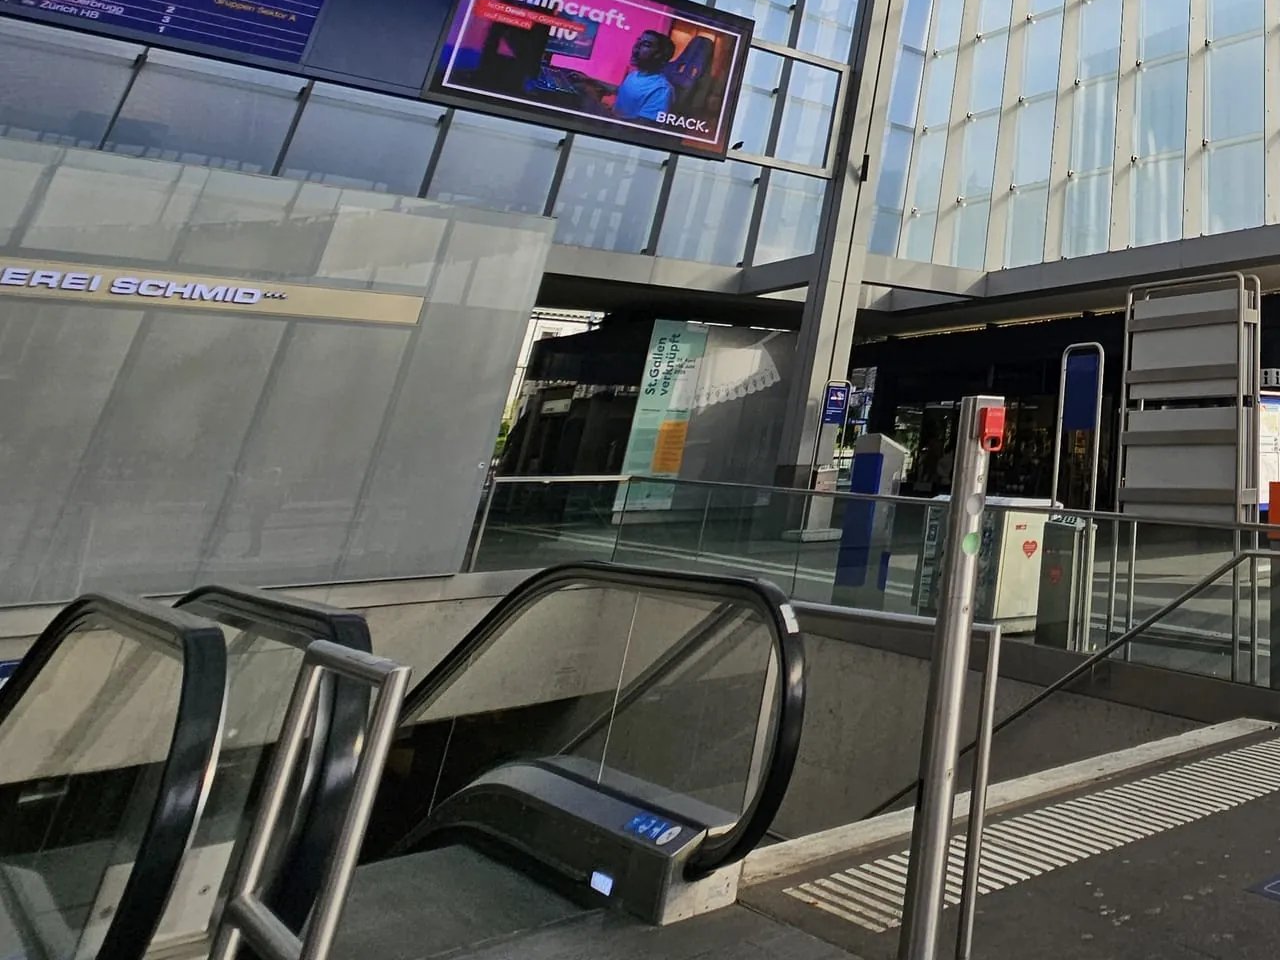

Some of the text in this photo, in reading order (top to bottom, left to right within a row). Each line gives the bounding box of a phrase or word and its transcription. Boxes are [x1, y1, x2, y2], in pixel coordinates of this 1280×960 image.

[39, 0, 165, 33] Zürich HB 1
[160, 15, 171, 23] 3
[165, 5, 175, 13] 2
[256, 6, 287, 19] Sektor
[287, 13, 297, 22] A
[656, 111, 709, 133] BRACK.
[0, 267, 262, 305] EREI SCHMID
[644, 336, 668, 396] St.Gallen
[660, 333, 681, 397] verknüpft
